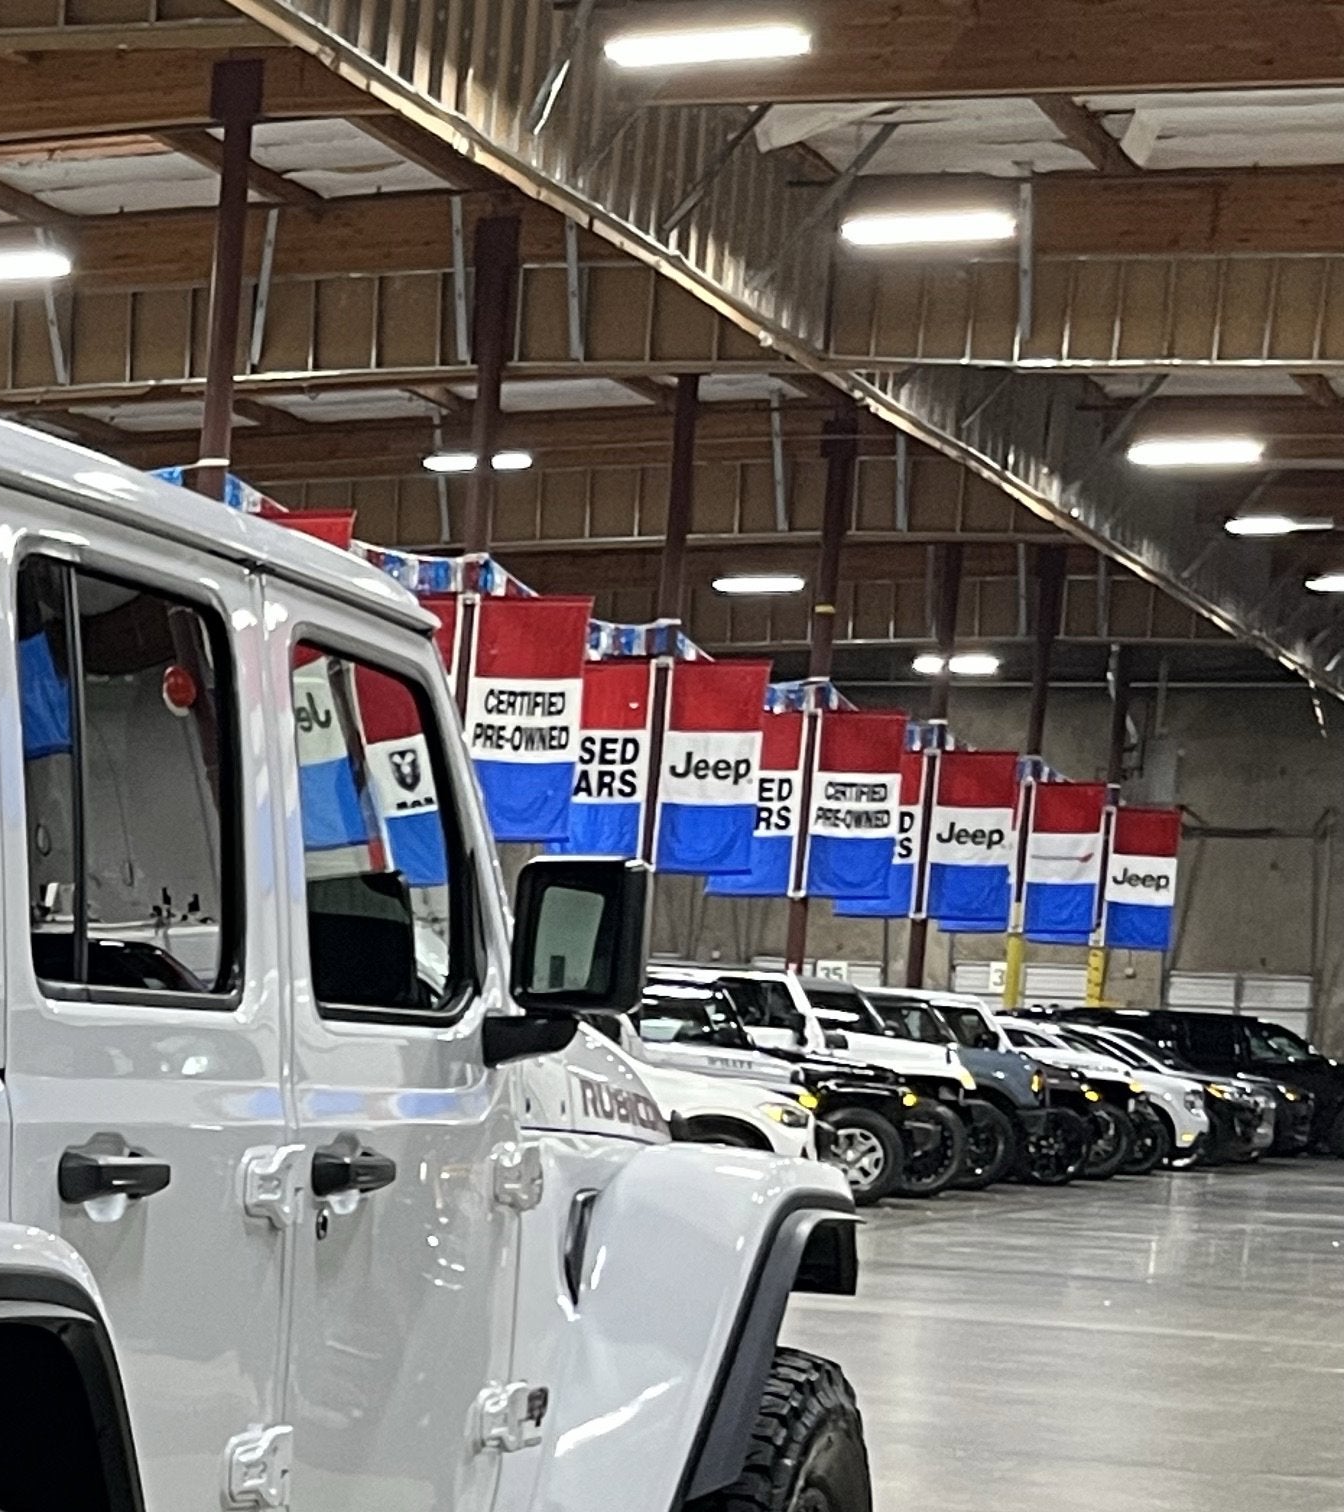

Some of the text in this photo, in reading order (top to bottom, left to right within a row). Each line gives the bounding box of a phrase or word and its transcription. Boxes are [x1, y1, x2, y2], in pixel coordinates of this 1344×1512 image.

[484, 688, 566, 717] CERTIFIED
[472, 722, 569, 751] PRE-OWNED
[578, 736, 640, 766] SED
[573, 768, 637, 798] ARS
[669, 751, 751, 786] Jeep
[936, 821, 1004, 851] Jeep
[1112, 866, 1170, 892] Jeep
[992, 968, 1006, 987] 3
